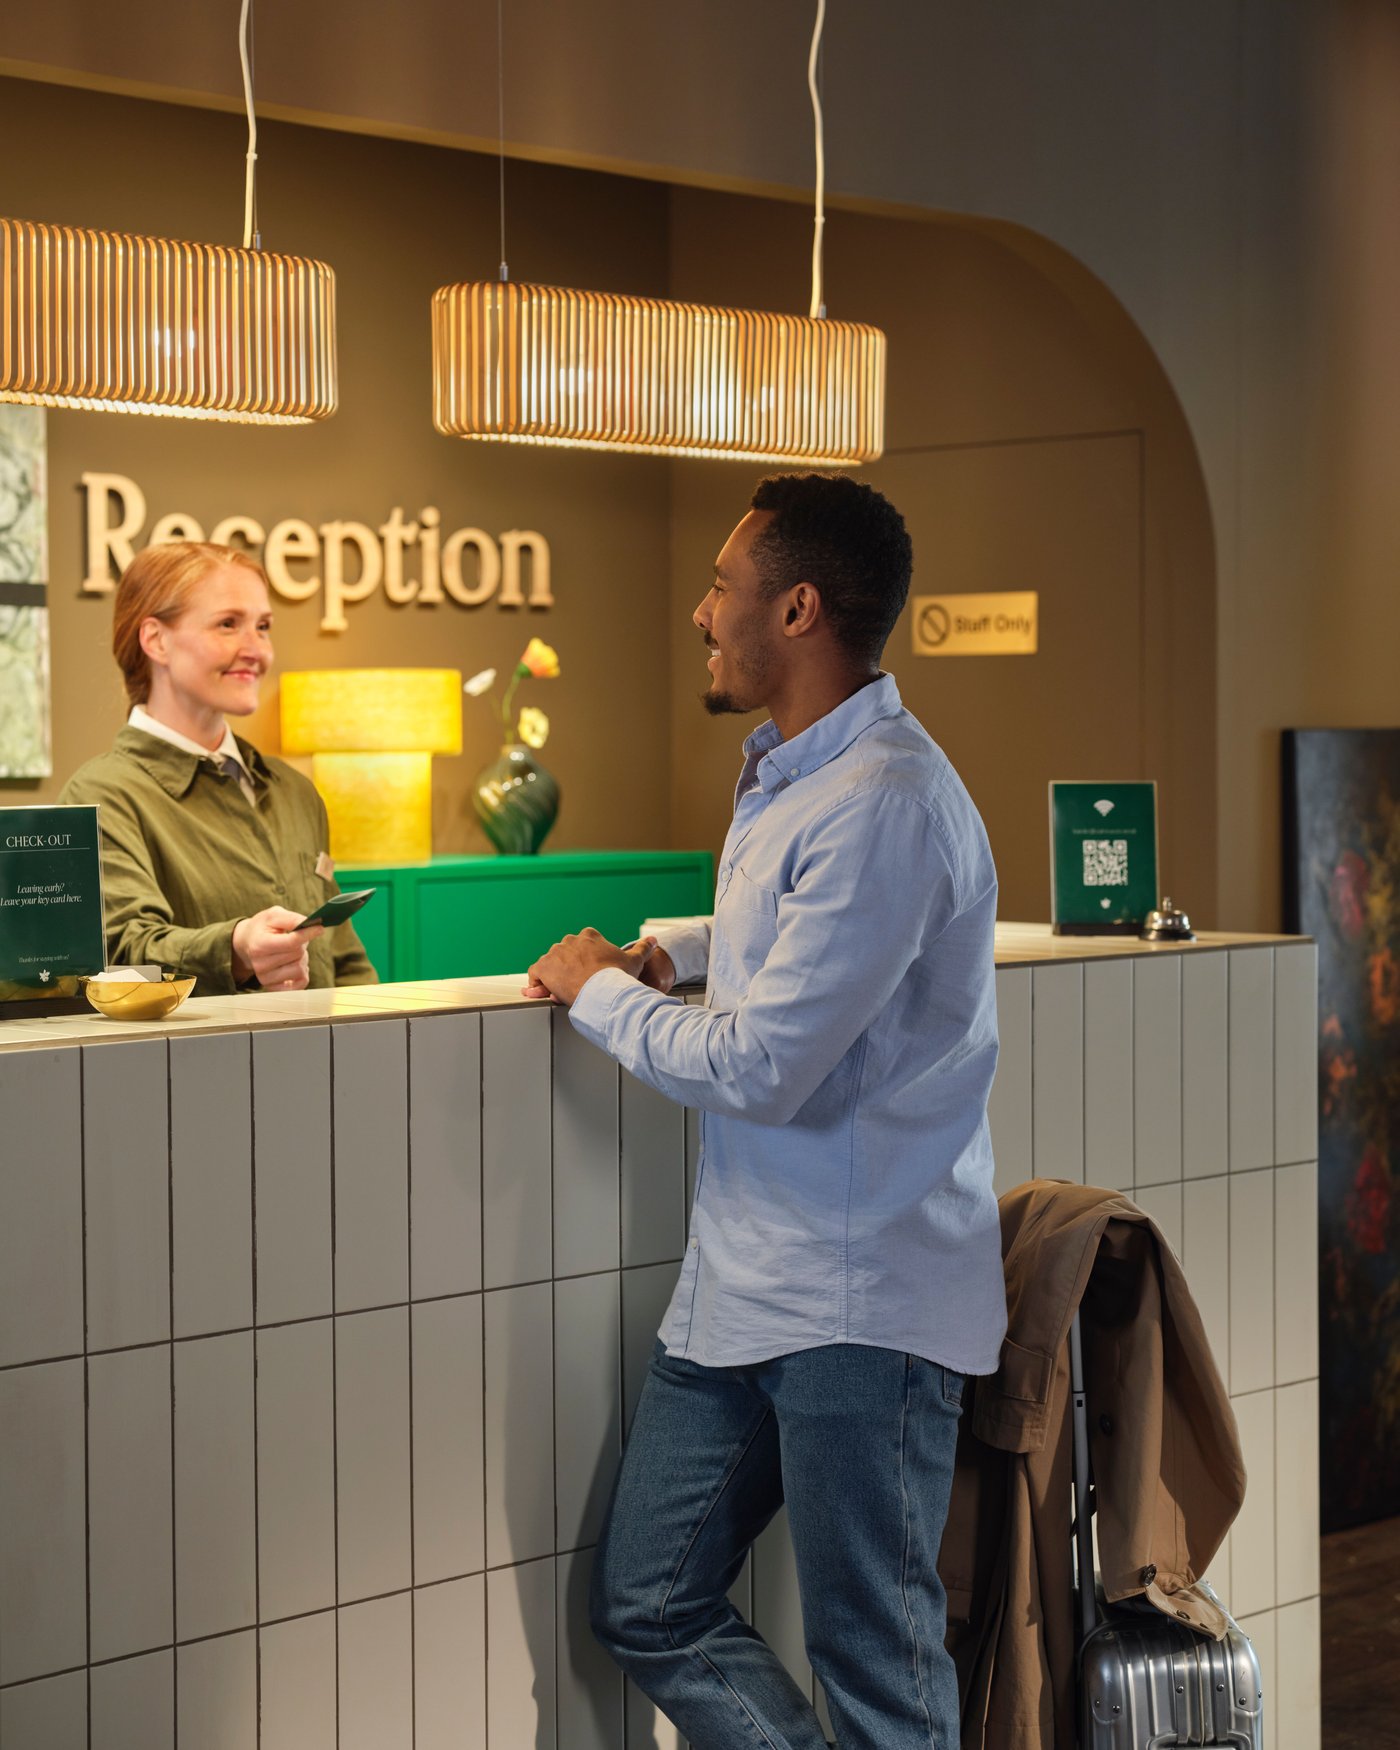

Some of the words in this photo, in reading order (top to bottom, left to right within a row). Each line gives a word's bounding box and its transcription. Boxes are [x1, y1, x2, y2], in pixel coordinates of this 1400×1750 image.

[954, 614, 991, 634] Staff
[993, 613, 1031, 637] Only
[6, 834, 71, 848] CHECK-OUT
[17, 884, 44, 894] Leaving
[44, 883, 65, 894] early?
[0, 897, 20, 906] Leave
[20, 898, 37, 907] your
[37, 895, 50, 906] key
[50, 894, 66, 904] card
[66, 894, 82, 903] here.
